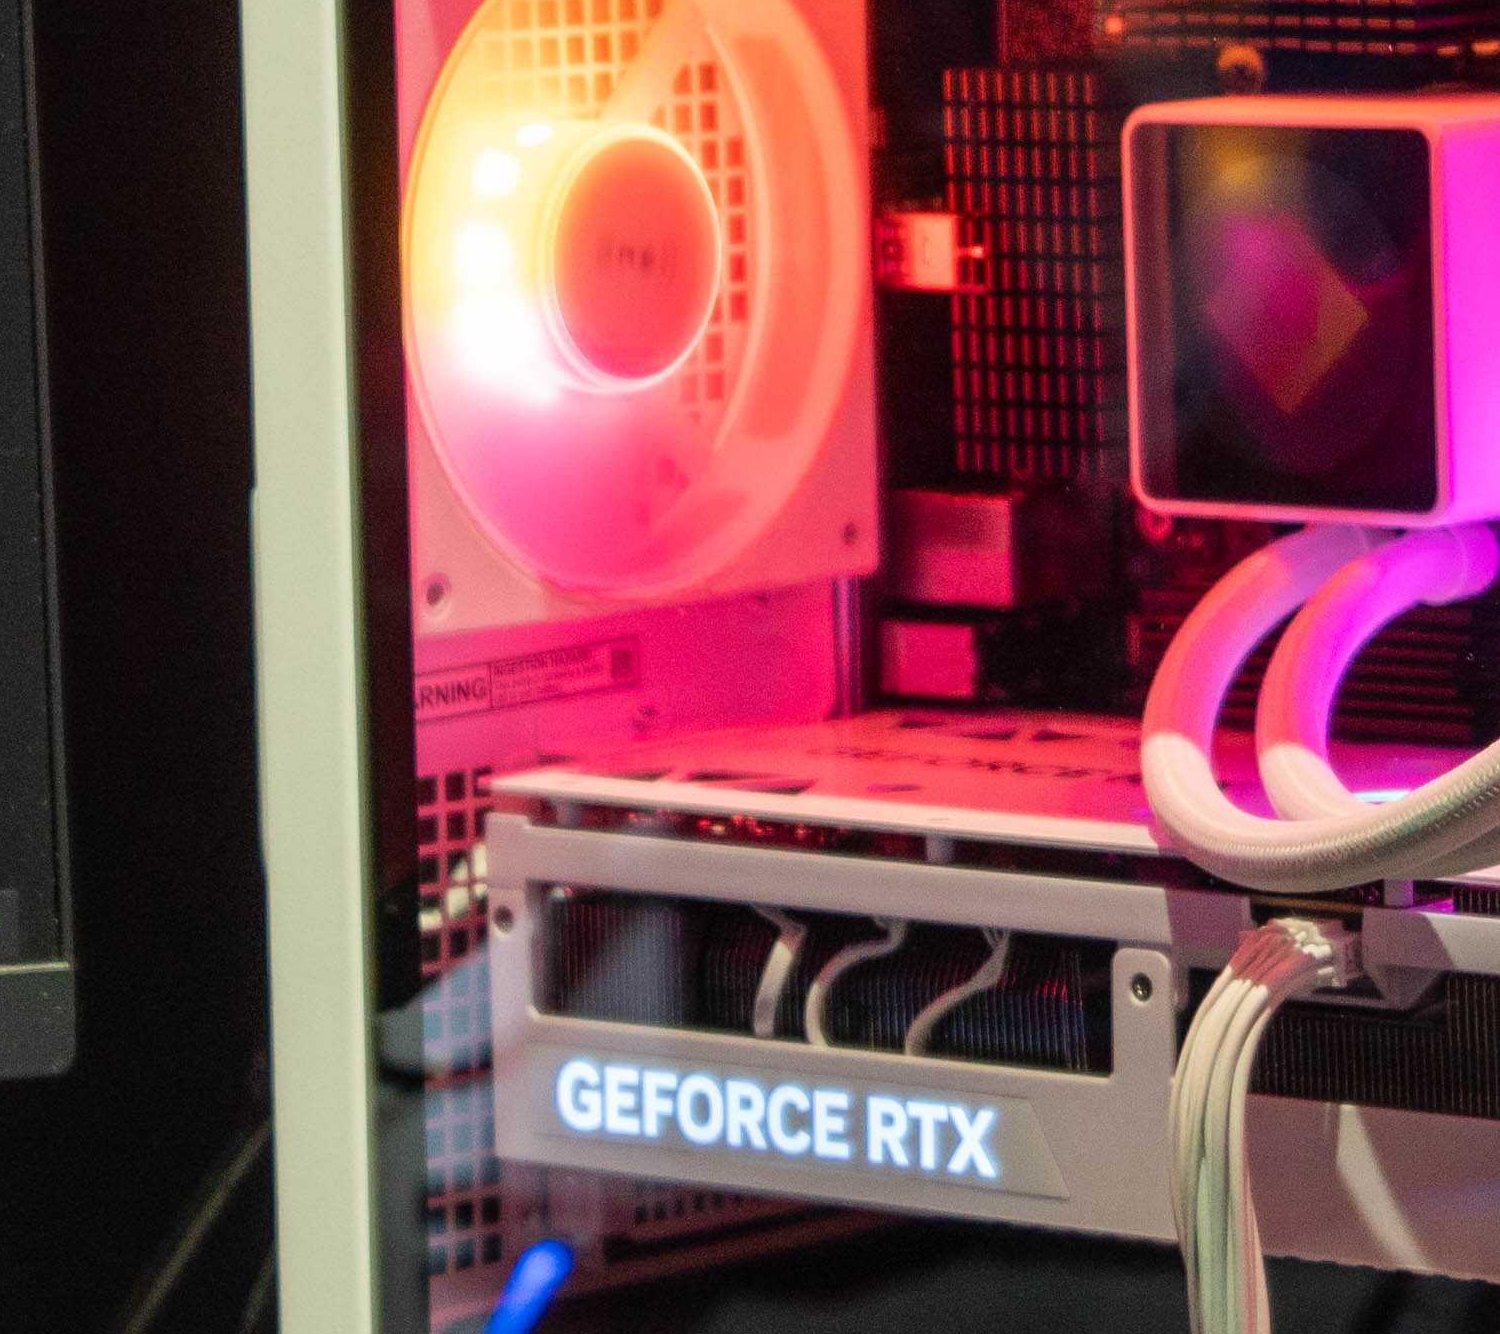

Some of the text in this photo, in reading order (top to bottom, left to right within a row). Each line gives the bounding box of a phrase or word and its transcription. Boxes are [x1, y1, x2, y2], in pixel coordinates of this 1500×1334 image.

[416, 676, 487, 709] RNING
[556, 1058, 999, 1179] GEFORCE RTX
